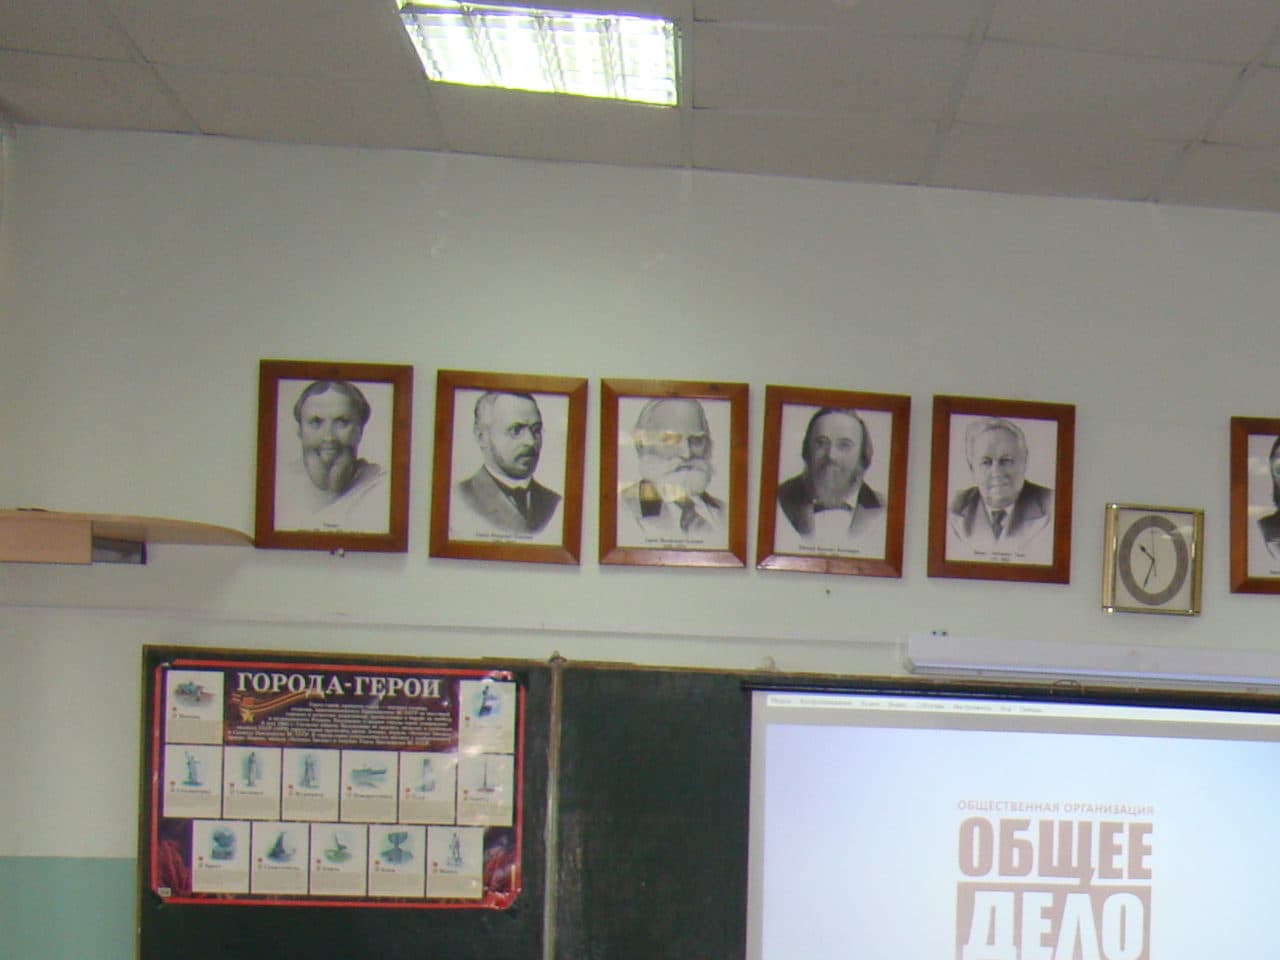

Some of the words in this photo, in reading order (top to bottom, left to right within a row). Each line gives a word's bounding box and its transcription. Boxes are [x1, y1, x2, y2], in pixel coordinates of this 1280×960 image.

[237, 672, 441, 698] ГОРОДА-ГЕРОИ
[957, 799, 1060, 813] ОБЩЕСТВЕННАЯ
[1063, 802, 1155, 816] ОРГАНИЗАЦИЯ
[958, 816, 1153, 885] ОБЩЕЕ
